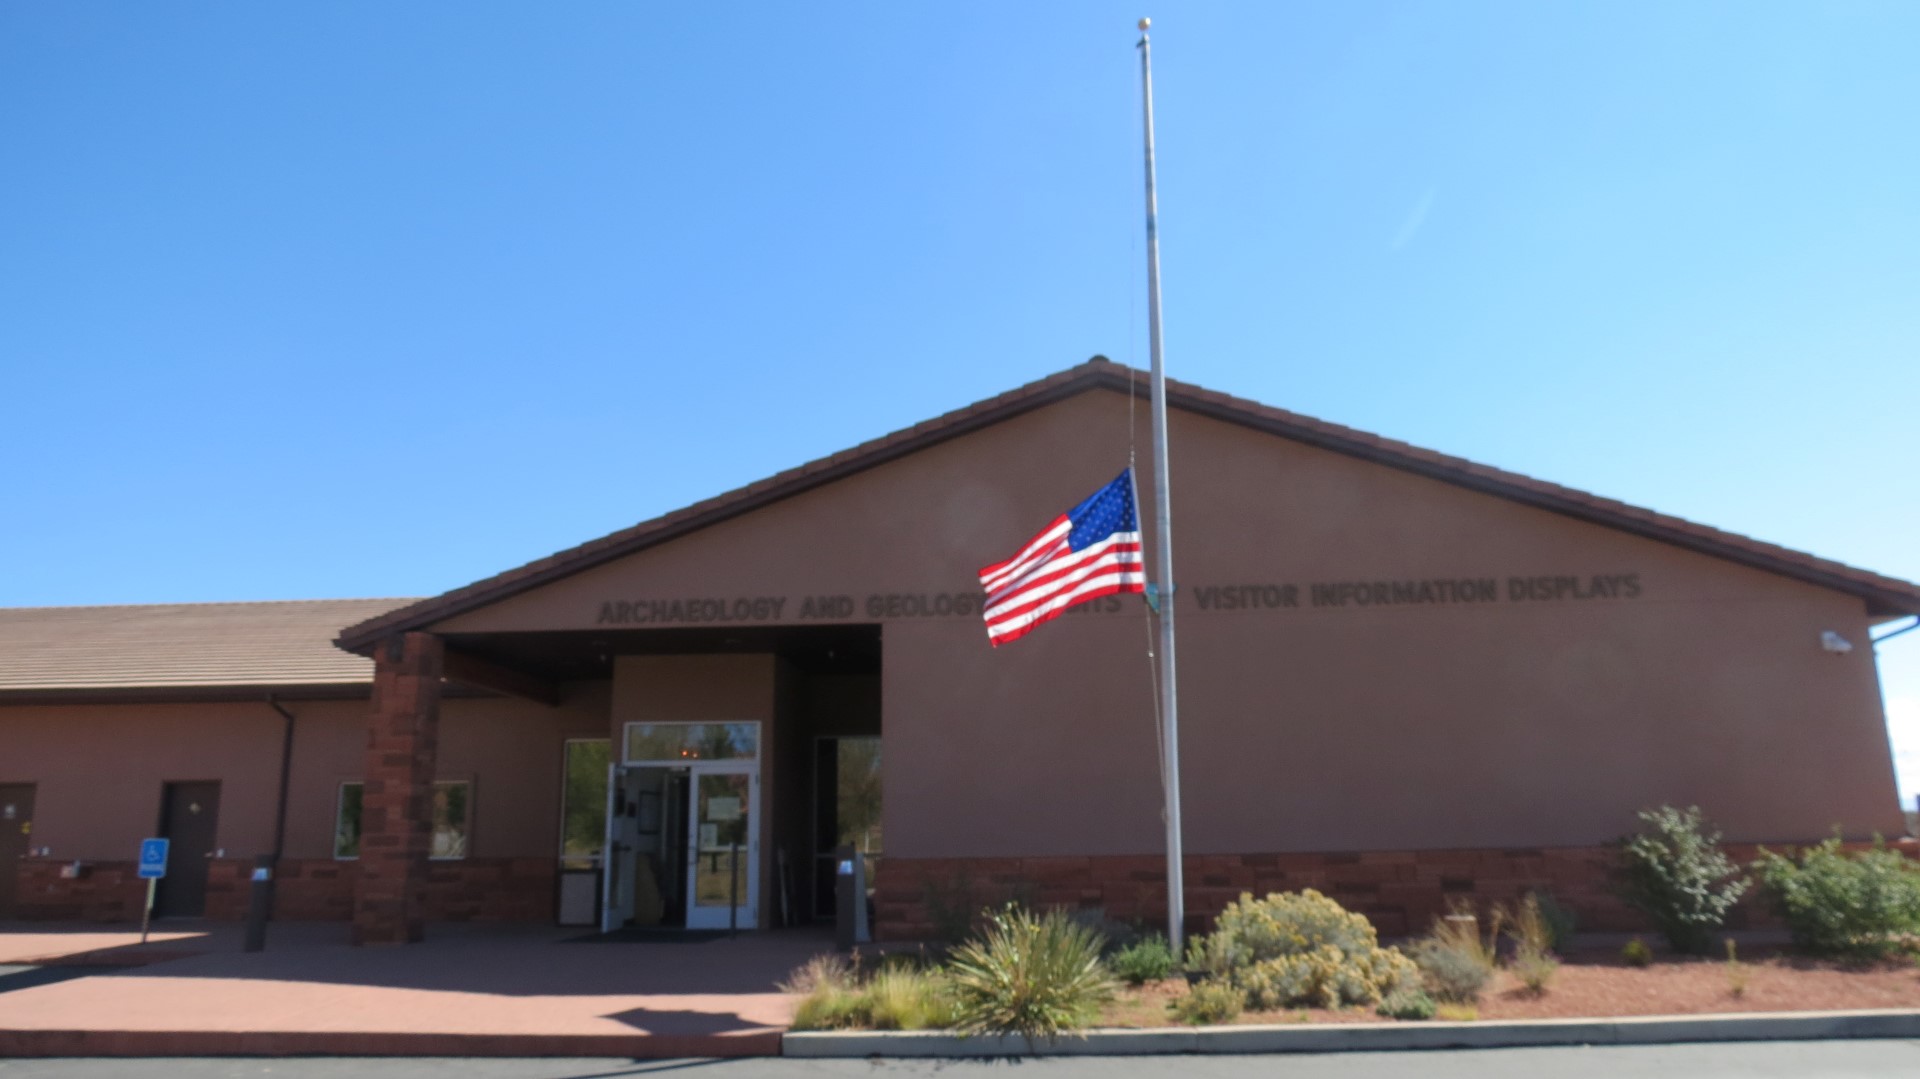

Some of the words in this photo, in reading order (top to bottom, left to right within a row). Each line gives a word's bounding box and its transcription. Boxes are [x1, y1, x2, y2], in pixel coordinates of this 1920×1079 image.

[597, 596, 786, 624] ARCHAEOLOGY
[799, 595, 854, 619] AND
[866, 591, 989, 618] GEOLOGY
[1193, 583, 1299, 610] VISITOR
[1310, 577, 1497, 607] INFORMATION
[1508, 573, 1643, 602] DISPLAYS
